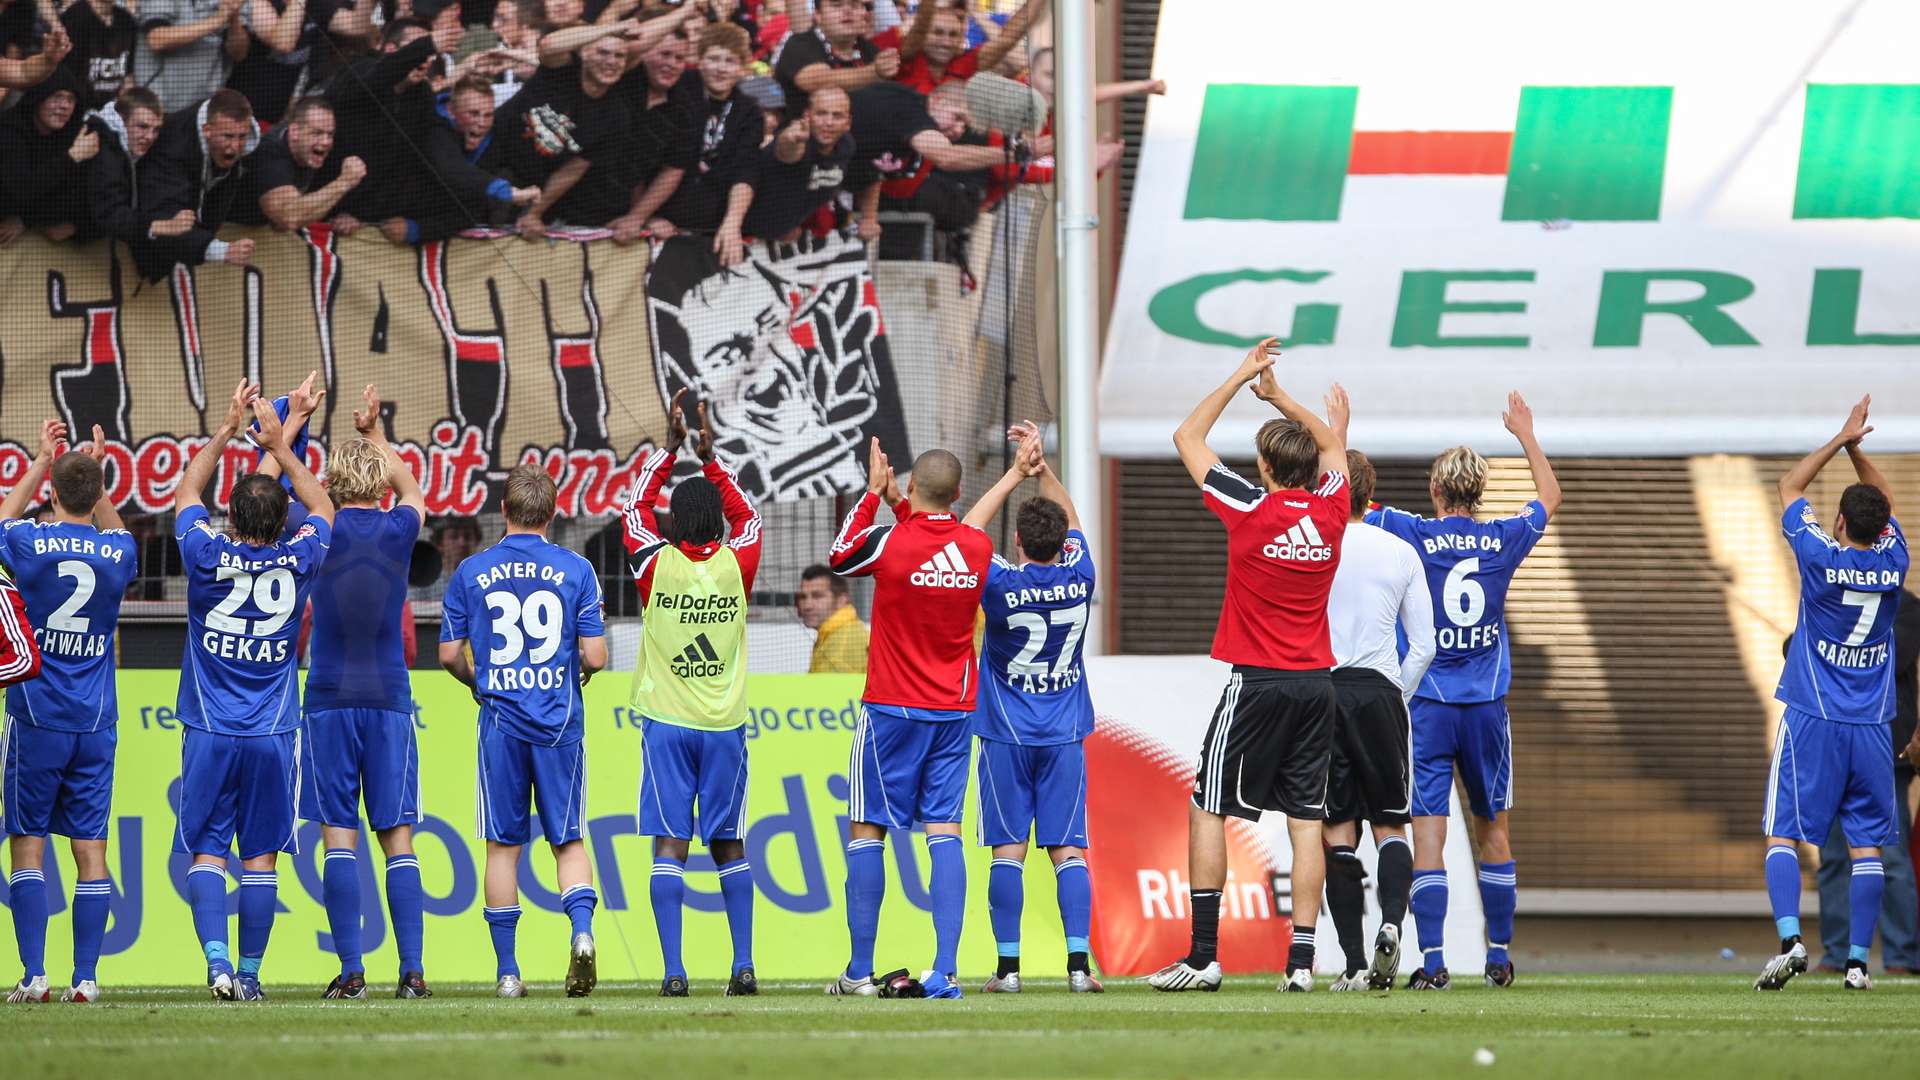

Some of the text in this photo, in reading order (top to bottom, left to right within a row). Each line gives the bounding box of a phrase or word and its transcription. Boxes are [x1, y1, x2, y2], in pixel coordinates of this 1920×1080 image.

[34, 537, 123, 564] BAYER 04
[1263, 542, 1332, 561] adidas
[1423, 534, 1502, 554] BAYER 04
[476, 562, 565, 590] BAYER 04
[910, 571, 978, 588] adidas
[1825, 568, 1900, 587] BAYER 04
[46, 560, 96, 633] 2
[205, 567, 296, 637] 29
[656, 592, 739, 610] TelDaFax
[1005, 582, 1087, 608] BAYER 04
[1443, 557, 1485, 627] 6
[484, 590, 563, 665] 39
[679, 610, 738, 624] ENERGY
[1842, 590, 1883, 647] 7
[33, 626, 106, 657] CHWAAB
[203, 631, 288, 662] GEKAS
[1006, 602, 1087, 675] 27
[1433, 622, 1500, 649] OLFES
[487, 667, 565, 690] KROOS
[670, 660, 726, 678] adidas
